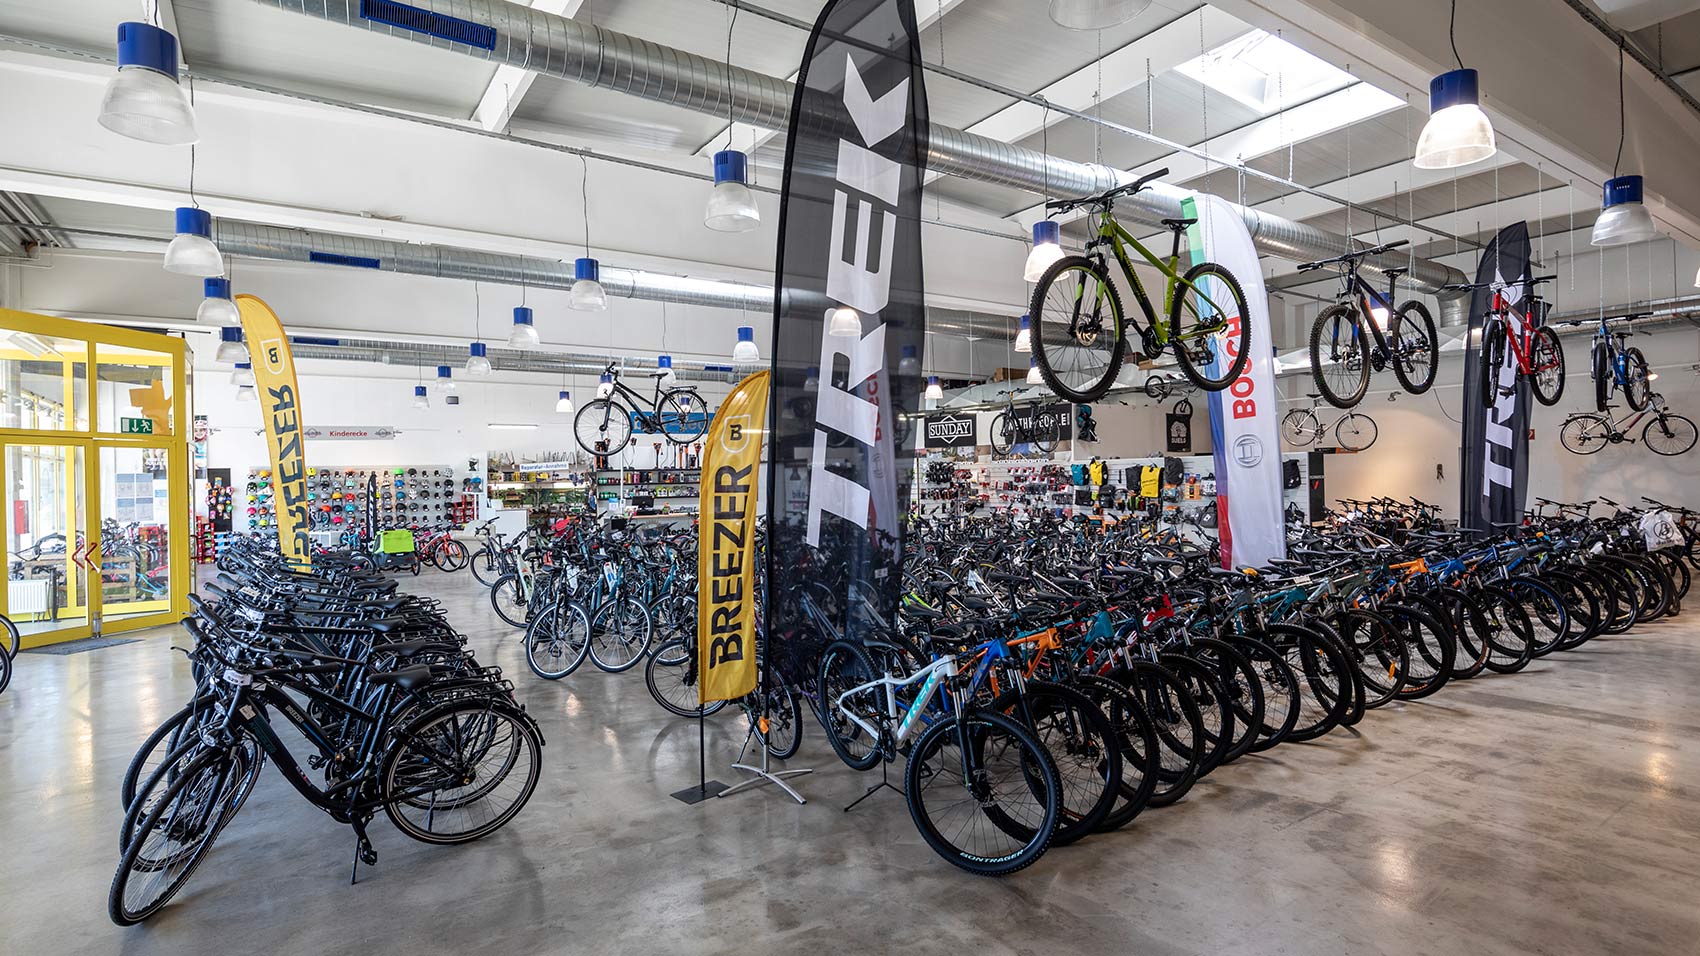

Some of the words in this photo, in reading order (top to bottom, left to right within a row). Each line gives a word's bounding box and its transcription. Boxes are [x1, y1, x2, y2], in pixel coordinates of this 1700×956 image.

[806, 52, 910, 548] TREK
[930, 422, 970, 437] SUNDAY
[709, 463, 753, 670] BREEZER
[959, 849, 1024, 863] BONTRAGER
